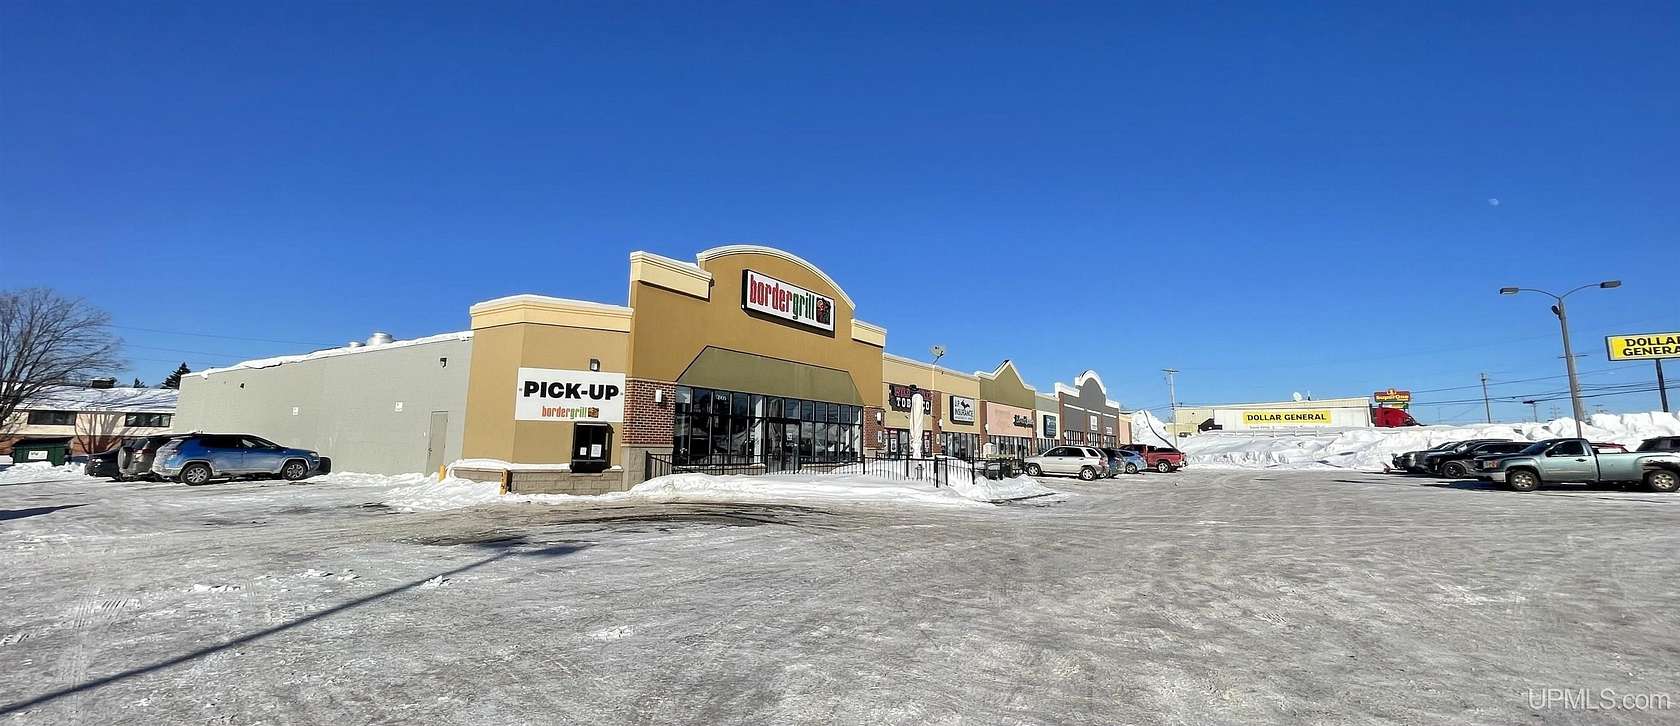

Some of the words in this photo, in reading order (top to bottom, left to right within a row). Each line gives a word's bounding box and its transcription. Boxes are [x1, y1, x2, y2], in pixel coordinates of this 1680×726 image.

[750, 274, 815, 320] bordergrill
[523, 380, 619, 400] PICK-UP
[542, 405, 588, 419] bordergrill
[896, 396, 930, 411] TOBCO
